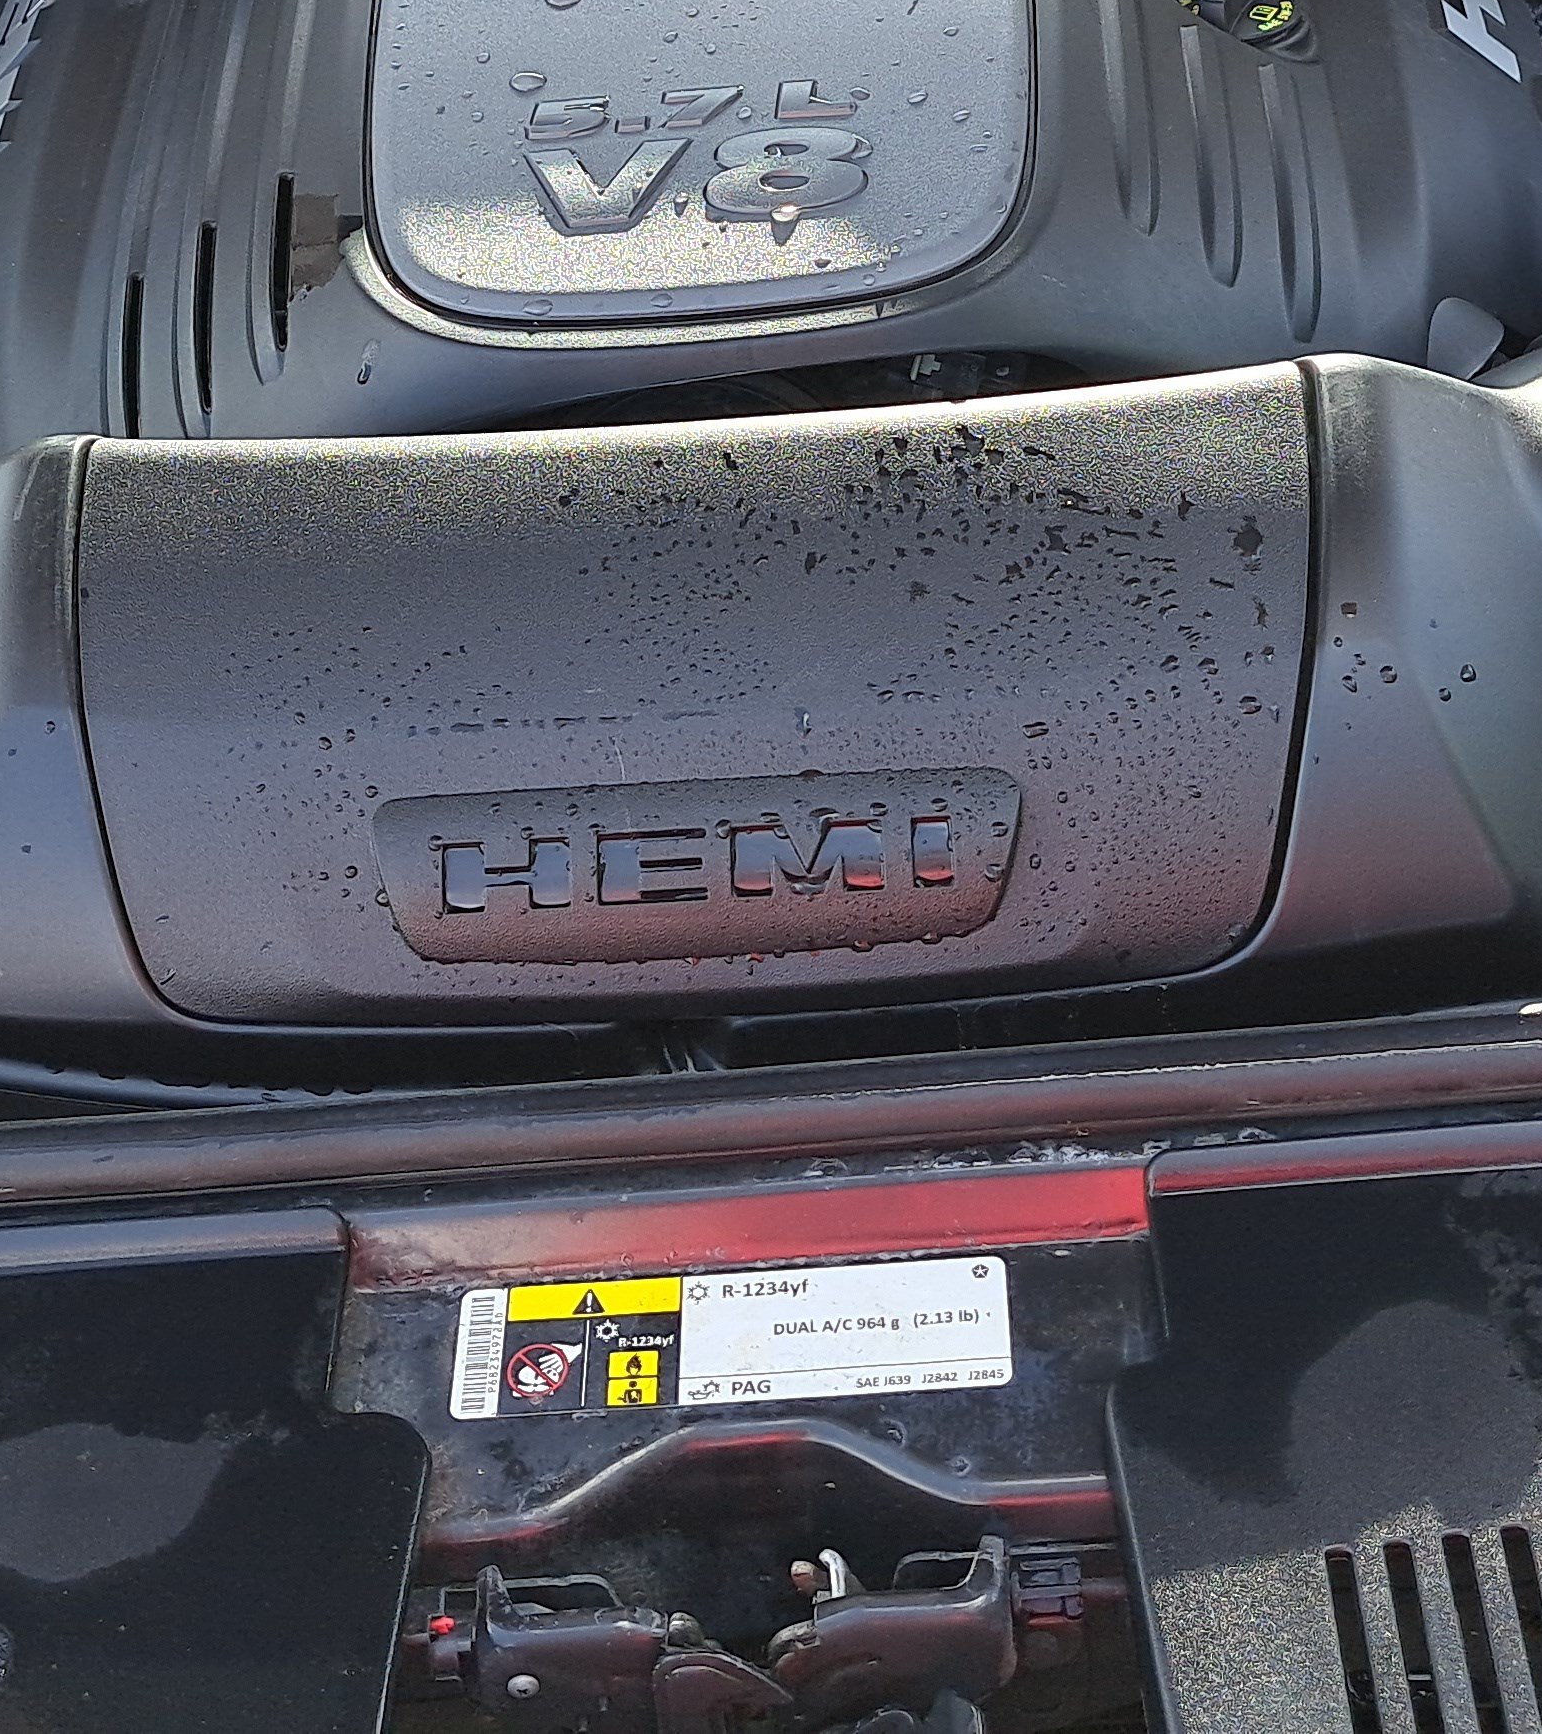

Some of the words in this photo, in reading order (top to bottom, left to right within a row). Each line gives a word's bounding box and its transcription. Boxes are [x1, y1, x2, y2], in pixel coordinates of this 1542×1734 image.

[523, 126, 873, 237] V8
[440, 814, 955, 915] HEMI
[722, 1278, 809, 1298] R-1234yf
[773, 1319, 818, 1336] DUAL
[822, 1317, 853, 1334] A/C
[857, 1317, 886, 1331] 964
[891, 1318, 900, 1331] g
[913, 1311, 953, 1329] (2.13
[958, 1308, 980, 1324] lb)
[618, 1332, 675, 1348] R-1234yf
[731, 1379, 772, 1396] PAG
[855, 1377, 880, 1389] SAE
[883, 1375, 912, 1386] J639
[921, 1372, 959, 1384] J2842
[967, 1369, 1005, 1381] J2845
